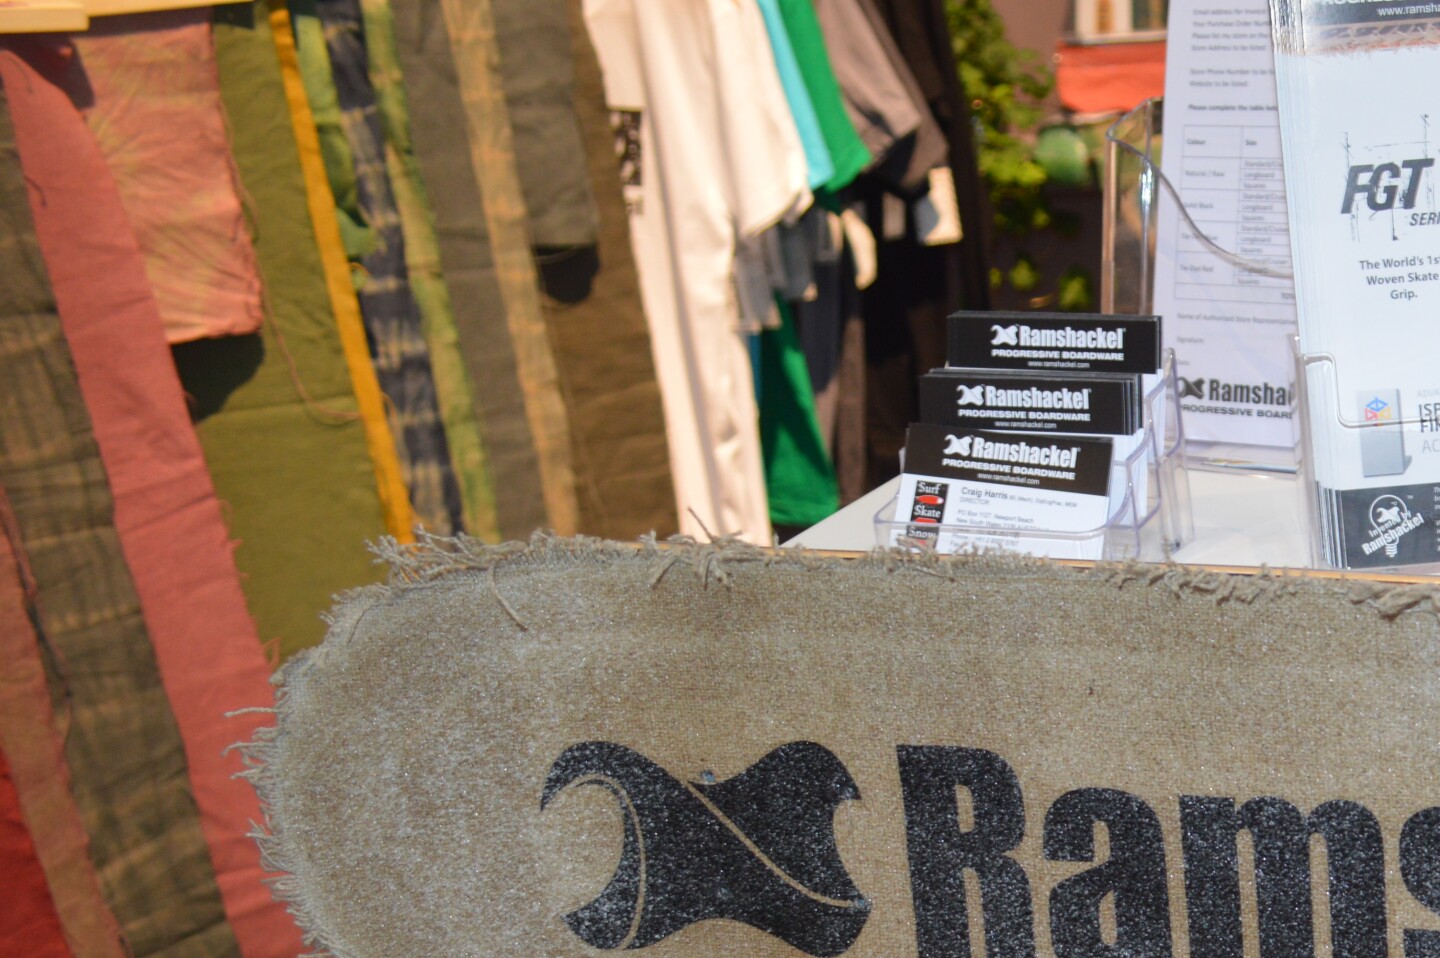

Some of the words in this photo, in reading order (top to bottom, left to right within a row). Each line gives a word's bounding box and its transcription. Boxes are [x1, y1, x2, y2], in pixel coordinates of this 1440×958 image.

[1341, 158, 1436, 215] FGT
[1359, 260, 1380, 270] The
[1382, 257, 1424, 268] World's
[1366, 274, 1405, 286] Woven
[1408, 271, 1439, 283] Skate
[1390, 289, 1418, 301] Grip.
[1019, 325, 1124, 350] Ramshackel
[991, 349, 1061, 359] PROGRESSIVE
[1061, 351, 1125, 362] BOARDWARE
[985, 385, 1090, 410] Ramshackel
[958, 408, 1027, 419] PROGRESSIVE
[1028, 410, 1091, 422] BOARDWARE
[972, 436, 1078, 469] Ramshackel
[942, 458, 1012, 473] PROGRESSIVE
[1012, 466, 1076, 480] BOARDWARE
[918, 482, 941, 494] Surf
[961, 486, 983, 498] Craig
[984, 489, 1008, 500] Harris
[960, 496, 990, 505] DIRECTOR
[914, 504, 941, 518] Skate
[908, 524, 937, 538] Snow
[1361, 512, 1425, 555] Ramshackel
[1368, 519, 1401, 537] Invented
